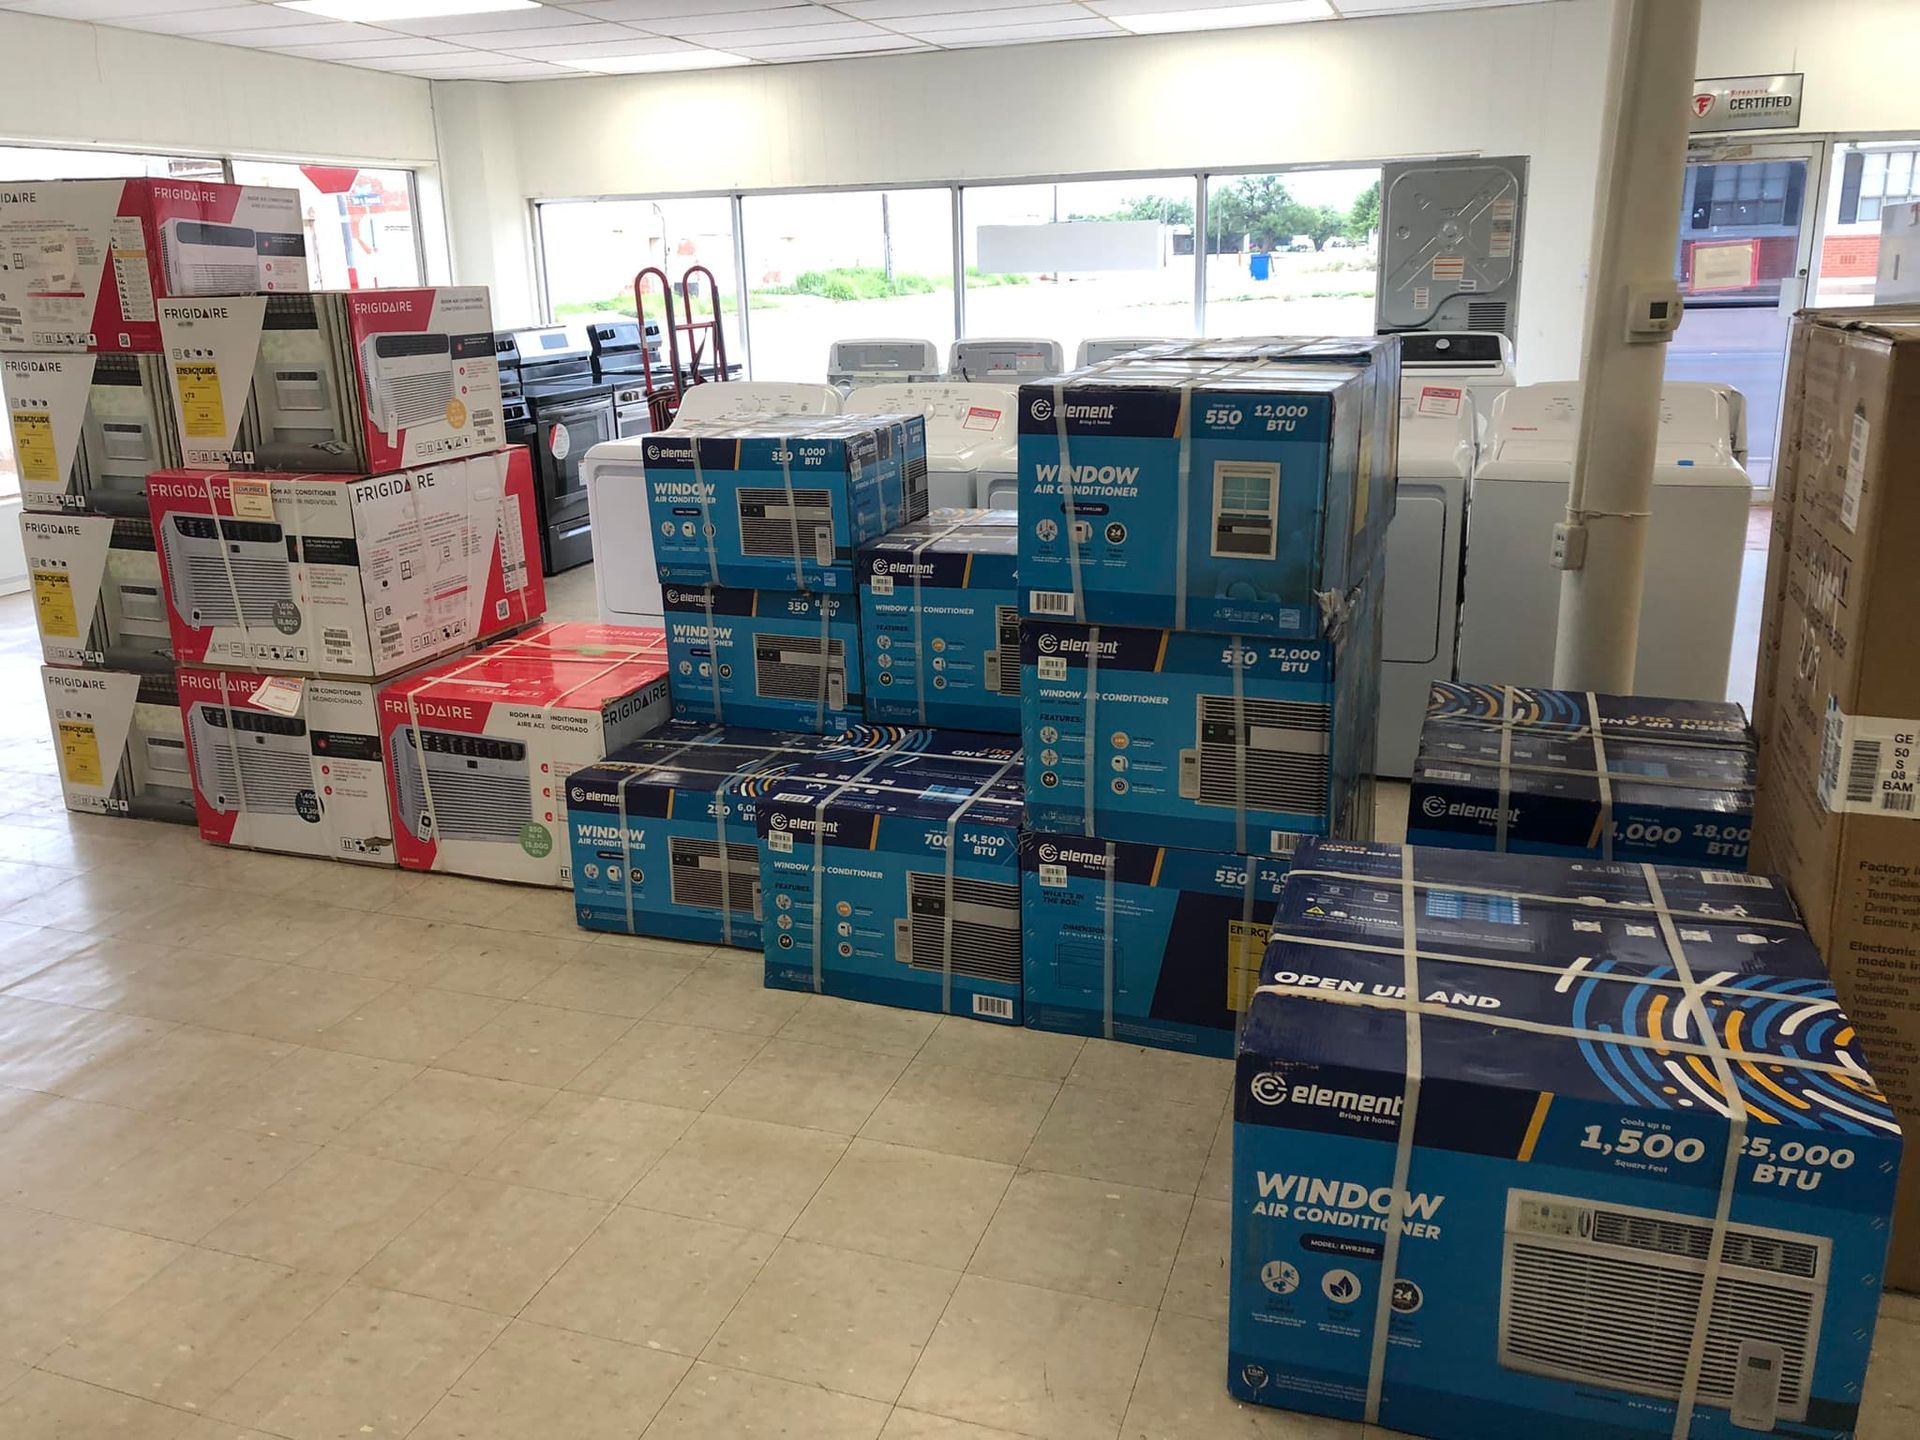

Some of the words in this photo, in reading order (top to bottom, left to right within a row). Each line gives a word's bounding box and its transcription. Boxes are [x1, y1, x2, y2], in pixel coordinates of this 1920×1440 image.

[1730, 96, 1792, 110] CERTIFIED
[154, 187, 216, 203] FRIGIDAIRE
[164, 307, 228, 319] FRIGIDAIRE
[355, 301, 413, 314] FRIGIDAIRE
[5, 361, 62, 373] FRIGIDAIRE
[1205, 409, 1243, 425] 550
[1254, 404, 1309, 418] 12,000
[1266, 419, 1297, 432] BTU
[661, 448, 695, 459] elemen
[804, 457, 822, 466] BTU
[150, 483, 230, 499] FRIGIDARE
[296, 488, 337, 497] CONDITIONER
[356, 473, 435, 503] FRIGIDARE
[1033, 484, 1055, 495] AIR
[1056, 485, 1139, 498] CNDITIONER
[25, 522, 81, 535] FRIGIDAIRE
[1110, 528, 1122, 538] 24
[787, 600, 809, 612] 350
[875, 604, 908, 612] WINDOW
[923, 606, 975, 615] CONDITIONER
[672, 636, 685, 644] AIR
[1268, 647, 1321, 661] 12,000
[1280, 661, 1310, 674] BTU
[49, 676, 107, 690] FRIGIDAIRE
[320, 688, 362, 696] CONDITIONER
[1039, 689, 1081, 700] WINDOW
[1102, 692, 1169, 705] CONDITIONER
[602, 682, 668, 728] FRIGIDAIRE
[509, 711, 529, 719] ROOM
[1894, 733, 1914, 744] GE
[1894, 748, 1910, 758] 50
[1895, 760, 1904, 769] S
[1891, 770, 1906, 780] 08
[1882, 780, 1914, 793] BAM
[578, 838, 592, 846] AIR
[962, 833, 1005, 847] 14,500
[973, 845, 997, 857] BTU
[1705, 841, 1748, 858] BTU
[773, 861, 809, 873] WINDOW
[827, 866, 883, 880] CONDITIONER
[1860, 860, 1910, 876] Factory
[1214, 869, 1249, 885] 550
[1350, 915, 1398, 925] CAUTION
[1849, 940, 1917, 957] Electronic
[1857, 957, 1907, 970] models
[1274, 970, 1365, 994] OPEN
[1424, 990, 1502, 1009] AND
[1291, 1083, 1404, 1117] element
[1339, 1111, 1362, 1123] Bring
[1620, 1117, 1646, 1128] Cools
[1647, 1121, 1660, 1131] up
[1661, 1122, 1672, 1131] to
[1580, 1125, 1706, 1164] 1,500
[1614, 1158, 1646, 1172] Square
[1648, 1163, 1669, 1174] Feet
[1752, 1163, 1823, 1191] BTU
[1256, 1171, 1446, 1221] WINDOW
[1252, 1201, 1288, 1218] AIR
[1310, 1239, 1339, 1249] MODEL:
[1393, 1288, 1413, 1301] 24
